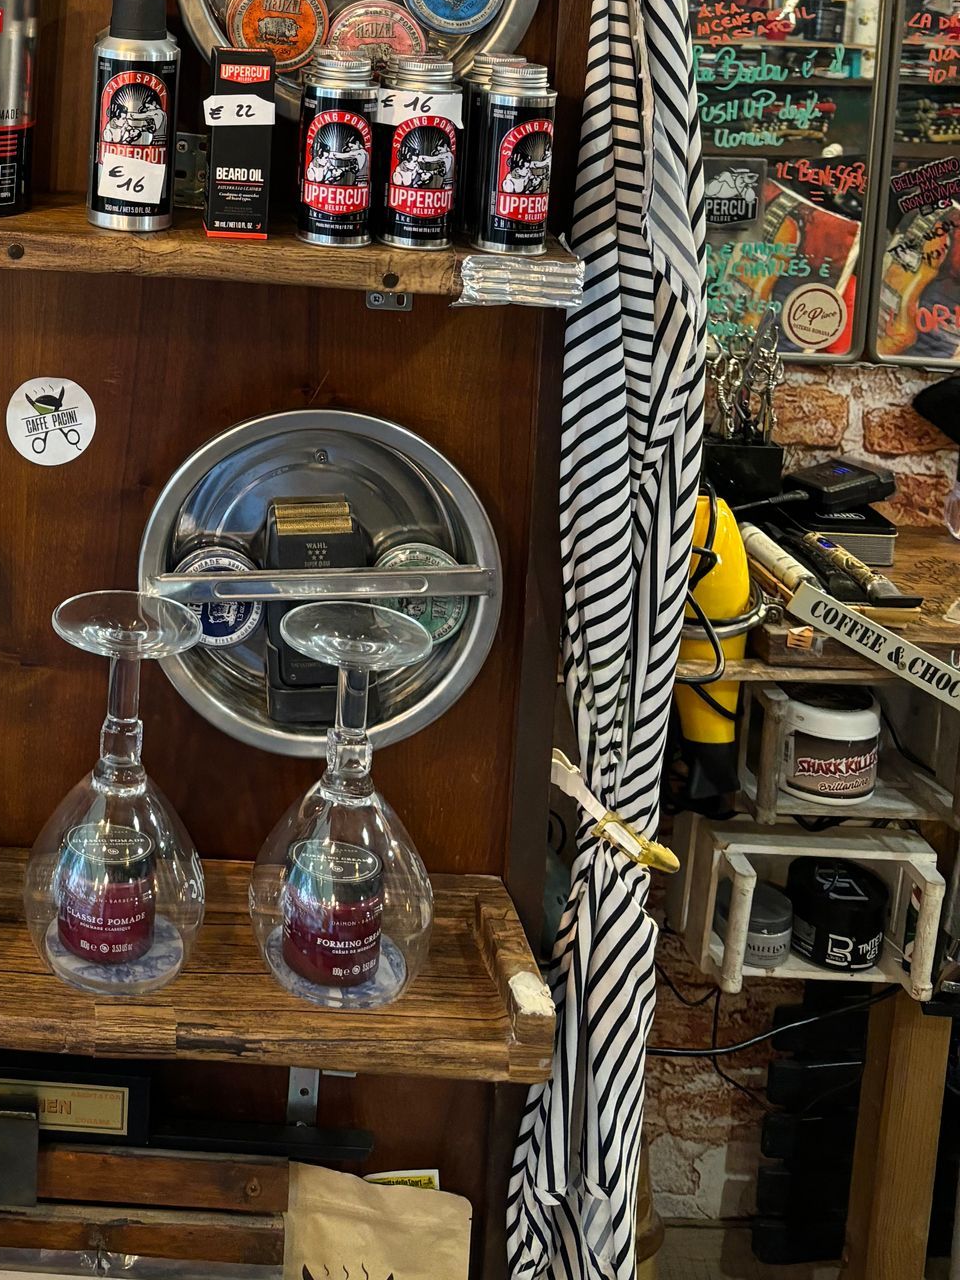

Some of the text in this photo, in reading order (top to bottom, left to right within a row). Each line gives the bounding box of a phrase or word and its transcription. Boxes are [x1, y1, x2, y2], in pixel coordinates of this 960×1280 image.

[907, 12, 932, 28] LA
[354, 21, 397, 39] REUZEL
[222, 65, 269, 79] UPPERCUT
[106, 73, 167, 98] SALT SPRAY
[209, 104, 255, 119] € 22
[381, 95, 433, 113] € 16
[743, 89, 776, 119] UP
[307, 113, 371, 148] STYLING POWDER
[393, 116, 427, 148] STYLING
[502, 122, 539, 156] STYLING
[108, 166, 124, 178] €
[216, 167, 264, 181] BEARD OIL
[776, 163, 793, 179] IL
[117, 176, 145, 193] 16
[305, 184, 368, 206] UPPERCUT
[390, 188, 453, 210] UPPERCUT
[499, 195, 548, 214] UPPERC
[706, 197, 758, 219] PERCUT
[26, 410, 78, 433] CAFFE PACINI
[306, 542, 328, 550] WAHL
[810, 600, 888, 654] COFFEE
[887, 646, 905, 668] &
[797, 758, 842, 777] SHARK
[818, 777, 870, 792] Brillantine
[67, 906, 146, 925] CLASSIC POMADE
[317, 938, 362, 948] FORMING
[866, 946, 879, 960] GEL
